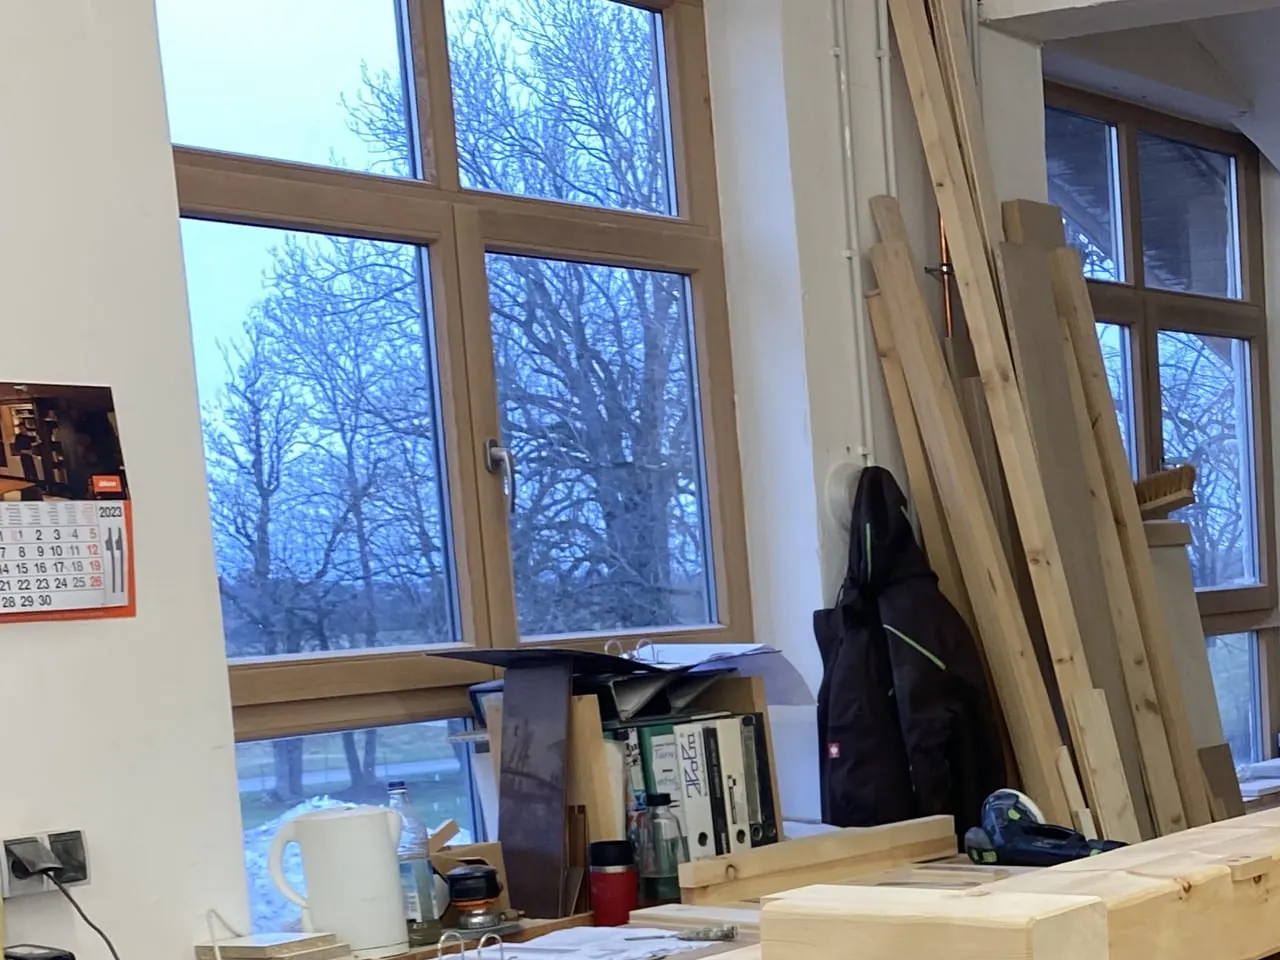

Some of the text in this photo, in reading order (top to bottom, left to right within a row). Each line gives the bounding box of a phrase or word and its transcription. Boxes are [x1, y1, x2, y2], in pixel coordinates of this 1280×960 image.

[99, 506, 122, 518] 2023
[35, 529, 43, 541] 2
[53, 529, 61, 541] 3
[72, 528, 79, 540] 4
[89, 528, 97, 540] 5
[0, 544, 99, 558] 7 8 9 10 11 12
[16, 562, 28, 574] 15
[34, 562, 47, 573] 16
[53, 561, 64, 573] 17
[72, 560, 84, 572] 18
[89, 560, 101, 571] 19
[0, 576, 102, 591] 21 22 23 24 25 26
[2, 594, 52, 608] 28 29 30
